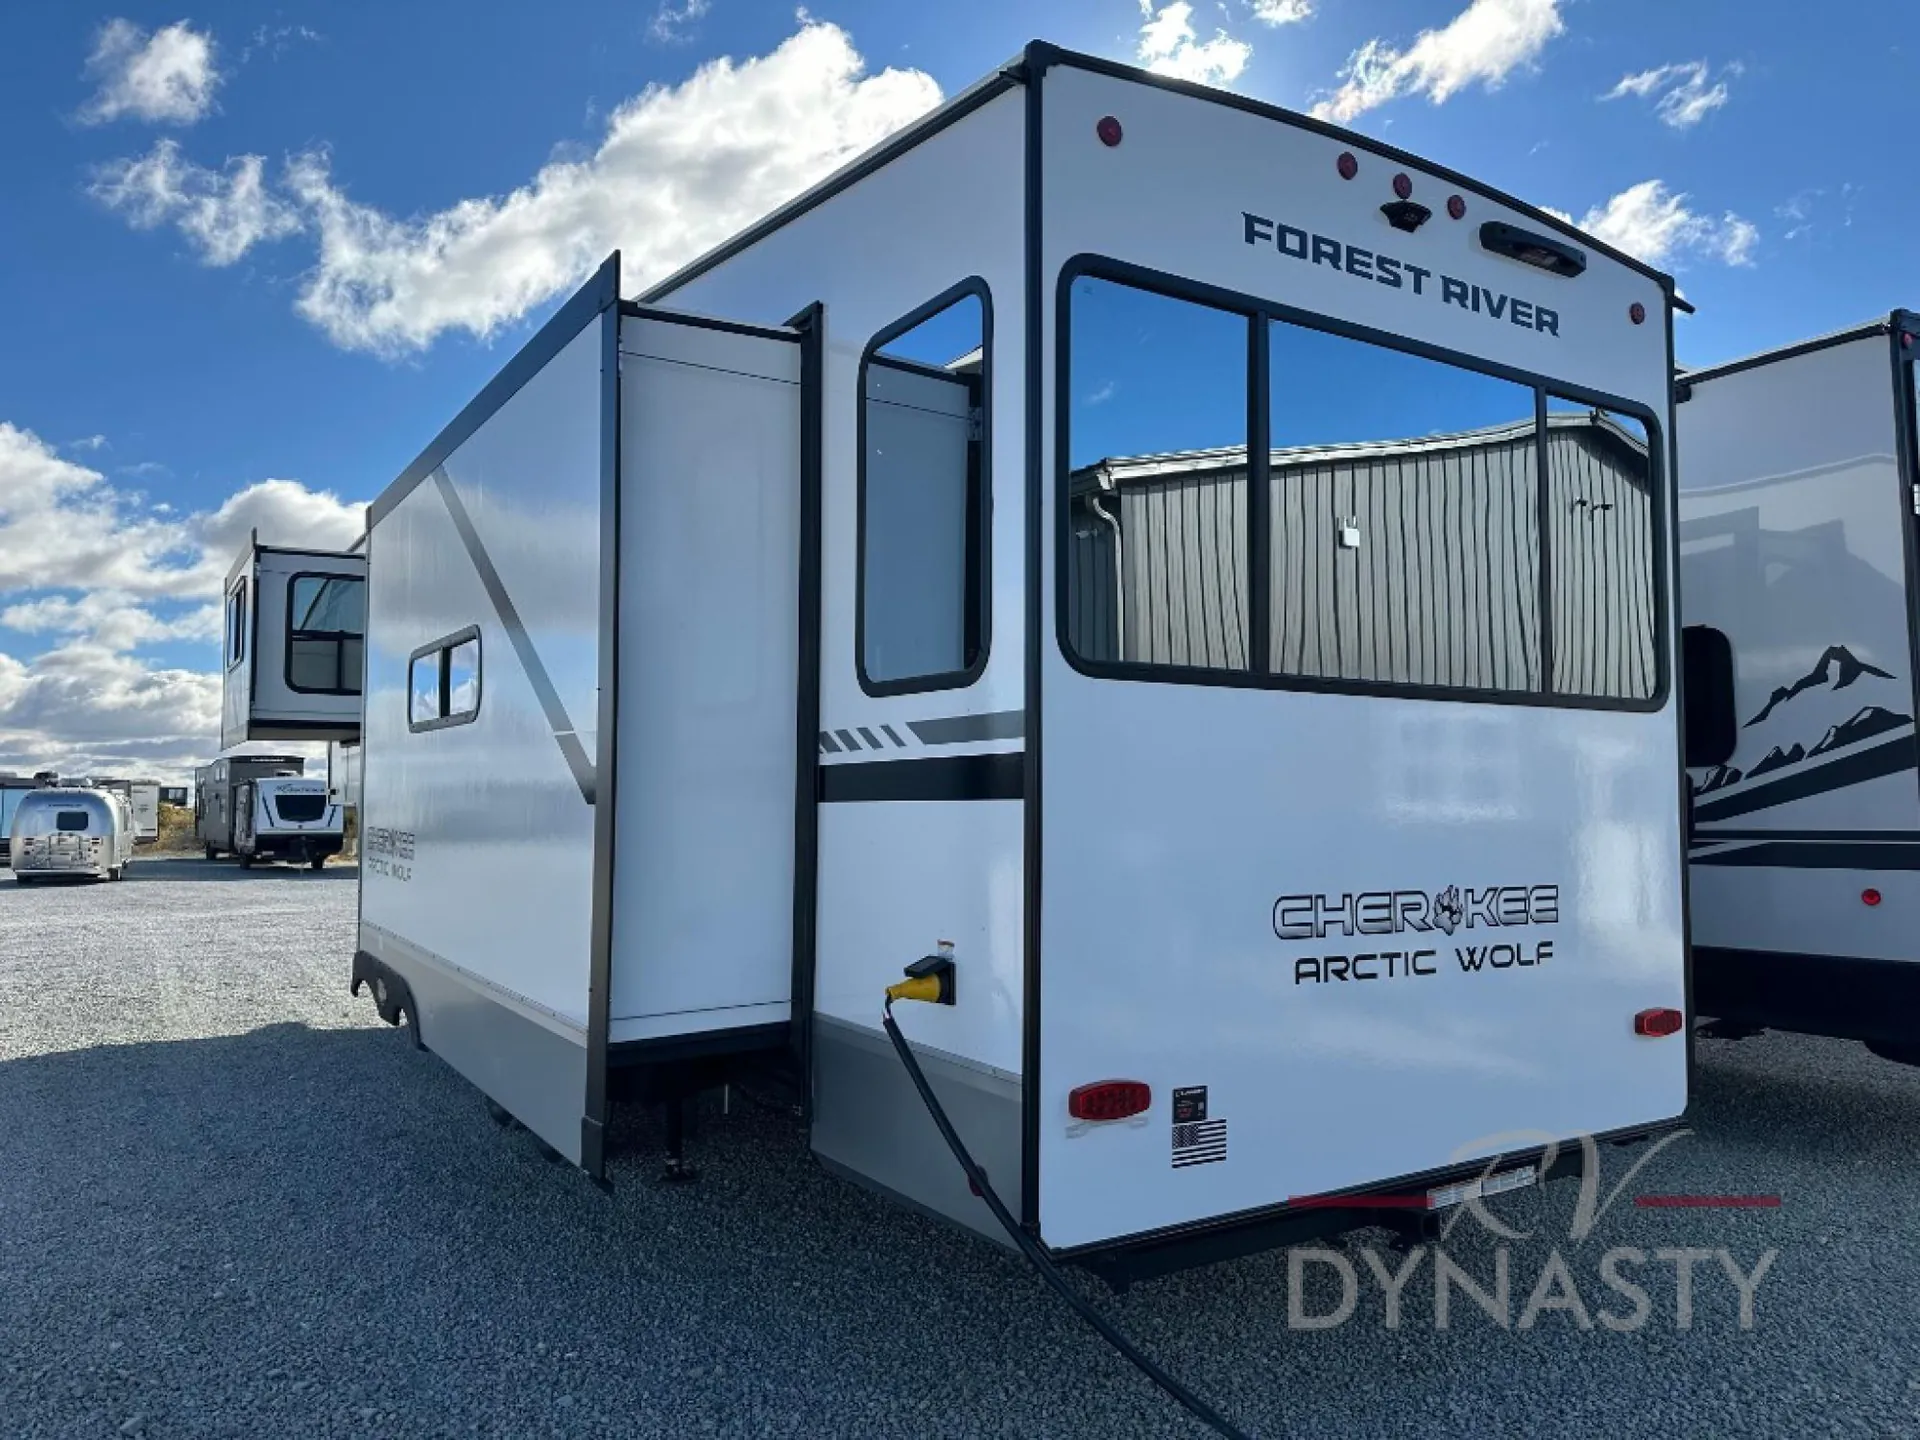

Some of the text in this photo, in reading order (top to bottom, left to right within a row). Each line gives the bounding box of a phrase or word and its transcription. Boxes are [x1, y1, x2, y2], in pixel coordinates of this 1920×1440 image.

[1242, 211, 1560, 337] FOREST RIVER
[1295, 940, 1554, 985] ARCTIC WOLF
